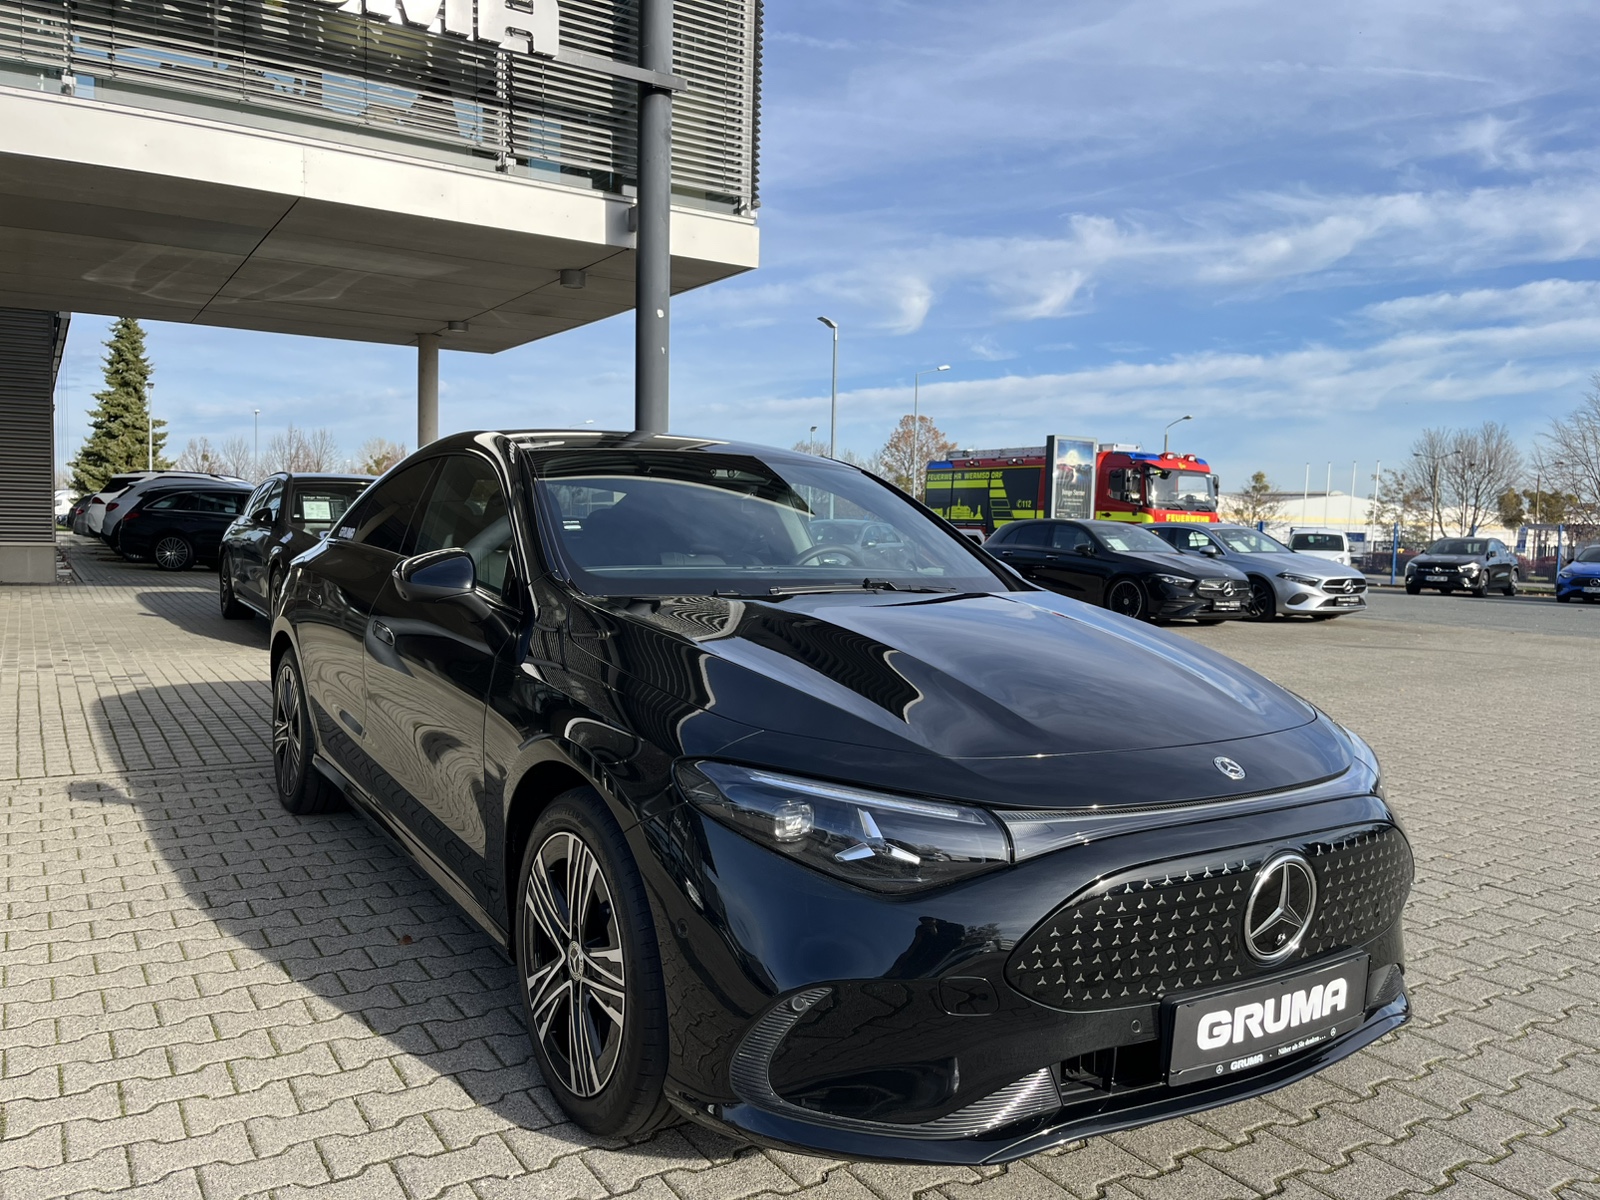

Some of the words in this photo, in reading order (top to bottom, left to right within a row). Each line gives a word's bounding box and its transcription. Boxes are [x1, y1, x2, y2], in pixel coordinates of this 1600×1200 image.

[1166, 513, 1210, 523] FEUERWEHR
[1196, 977, 1348, 1050] GRUMA
[1230, 1054, 1264, 1071] GRUMA
